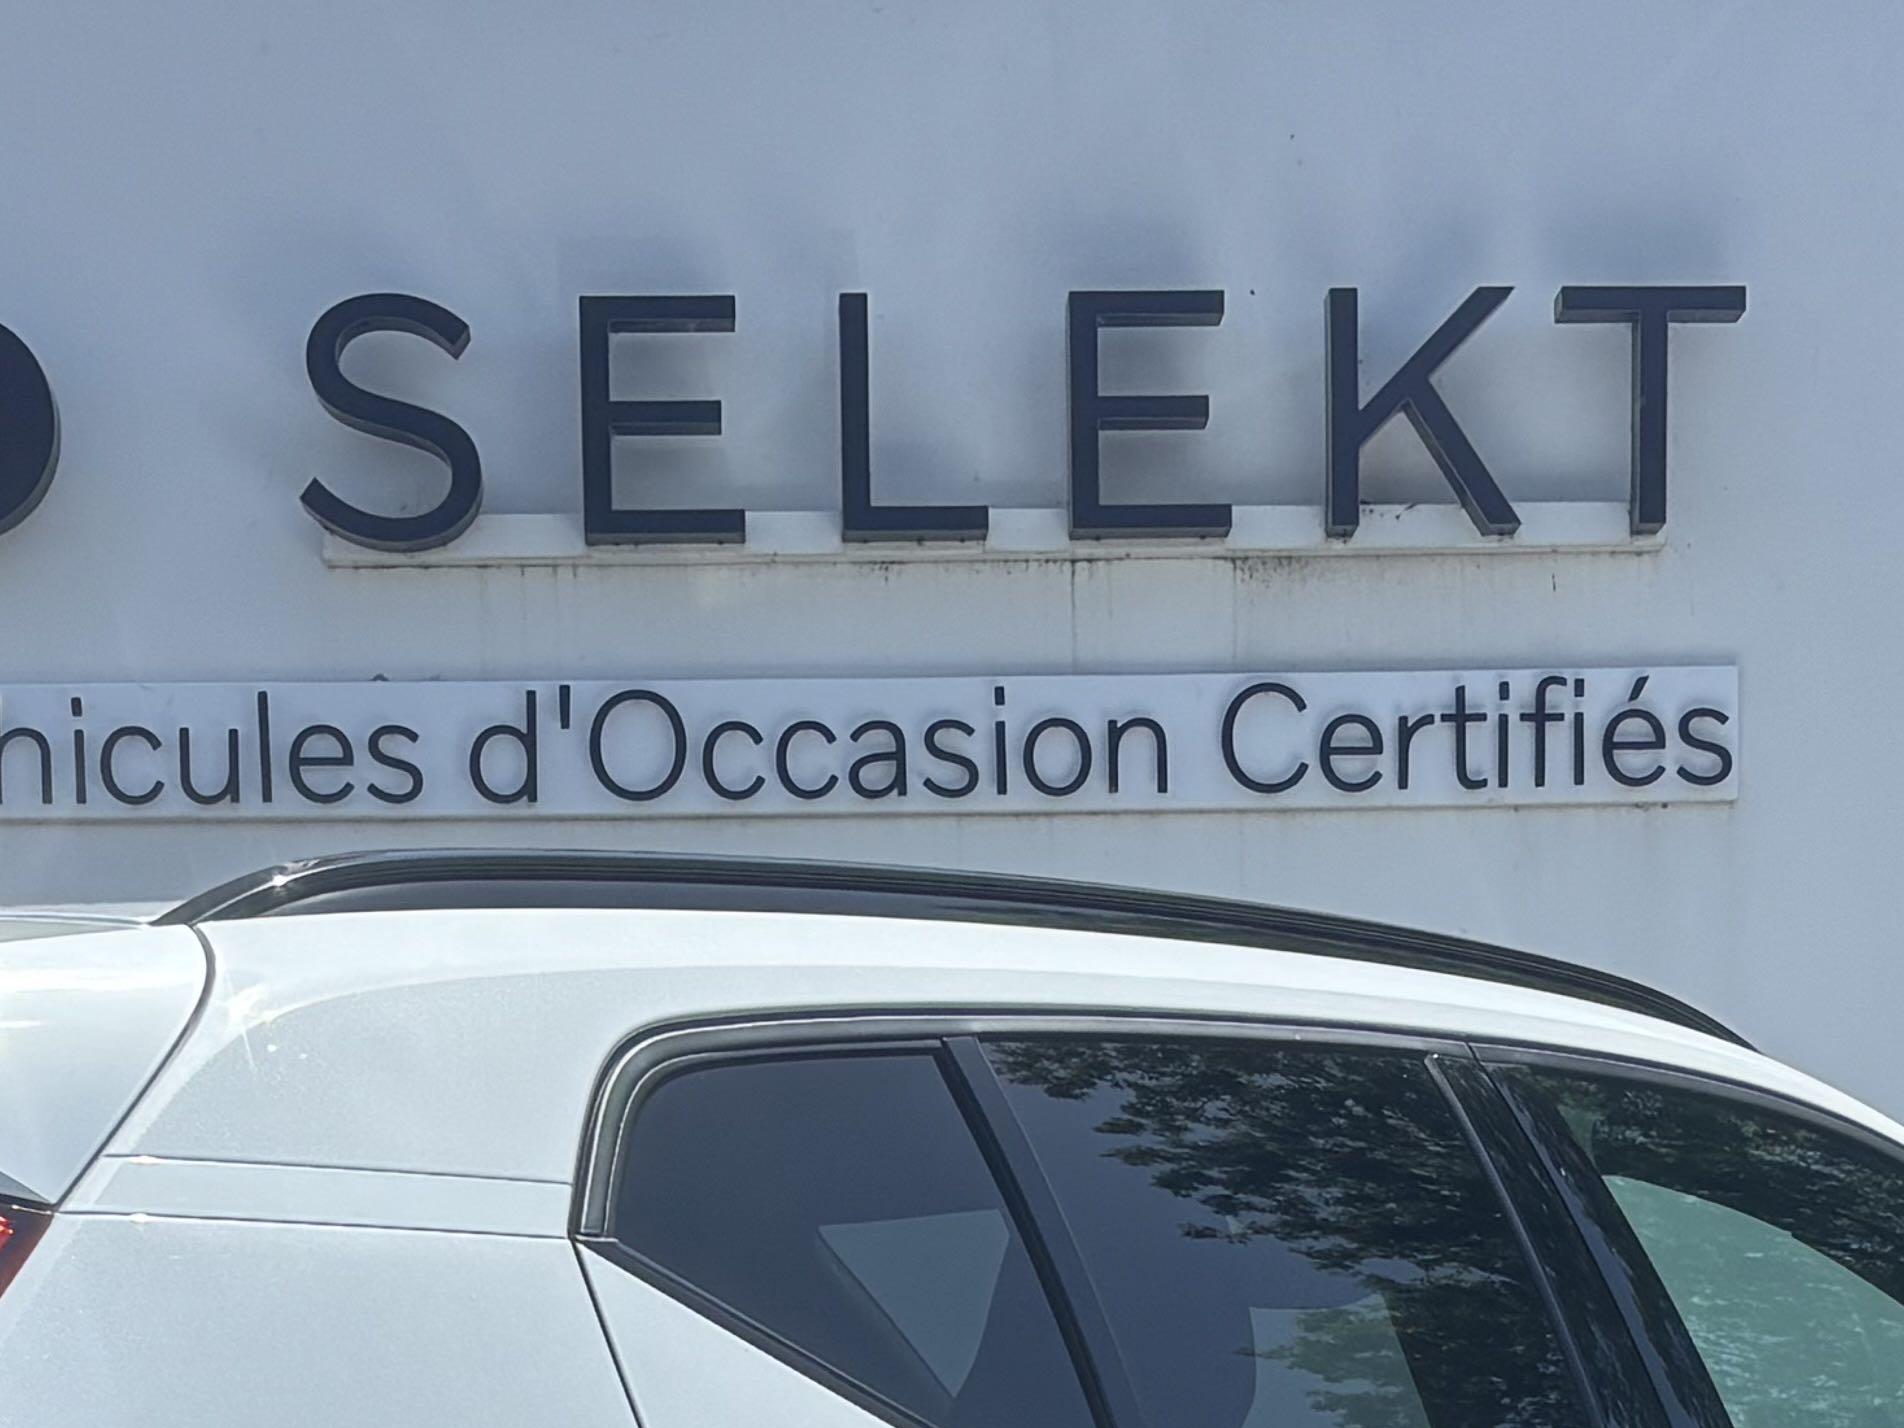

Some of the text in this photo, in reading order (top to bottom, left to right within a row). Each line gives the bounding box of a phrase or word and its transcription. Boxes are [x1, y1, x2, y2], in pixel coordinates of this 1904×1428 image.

[299, 286, 1747, 552] SELEKT
[467, 684, 1172, 802] d'Occasion
[1220, 675, 1737, 796] Certifiés
